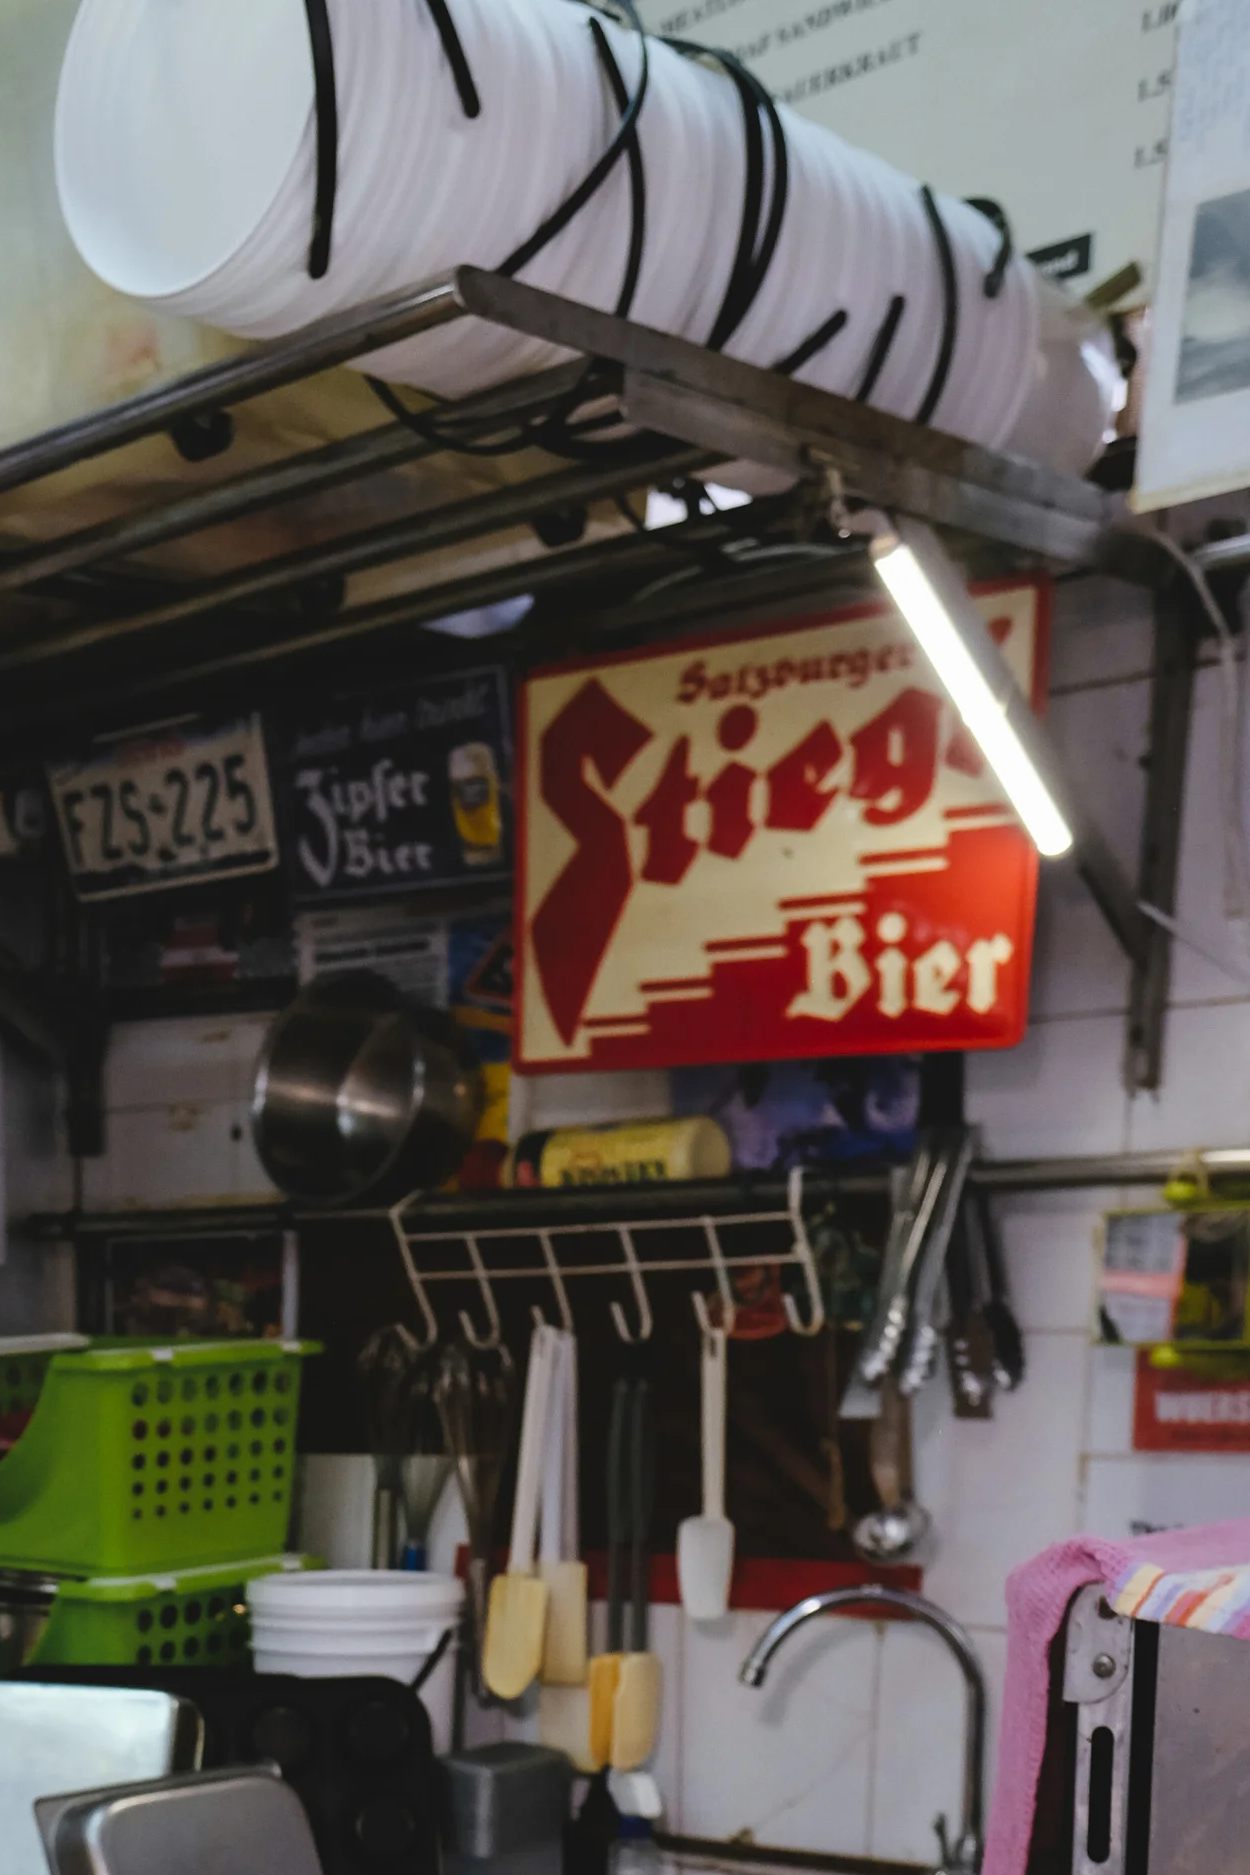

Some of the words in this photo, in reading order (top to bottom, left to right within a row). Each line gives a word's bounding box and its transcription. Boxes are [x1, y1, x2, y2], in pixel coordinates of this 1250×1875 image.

[295, 757, 431, 887] Zipfer
[344, 827, 433, 878] Bier
[784, 911, 1013, 1022] Bier
